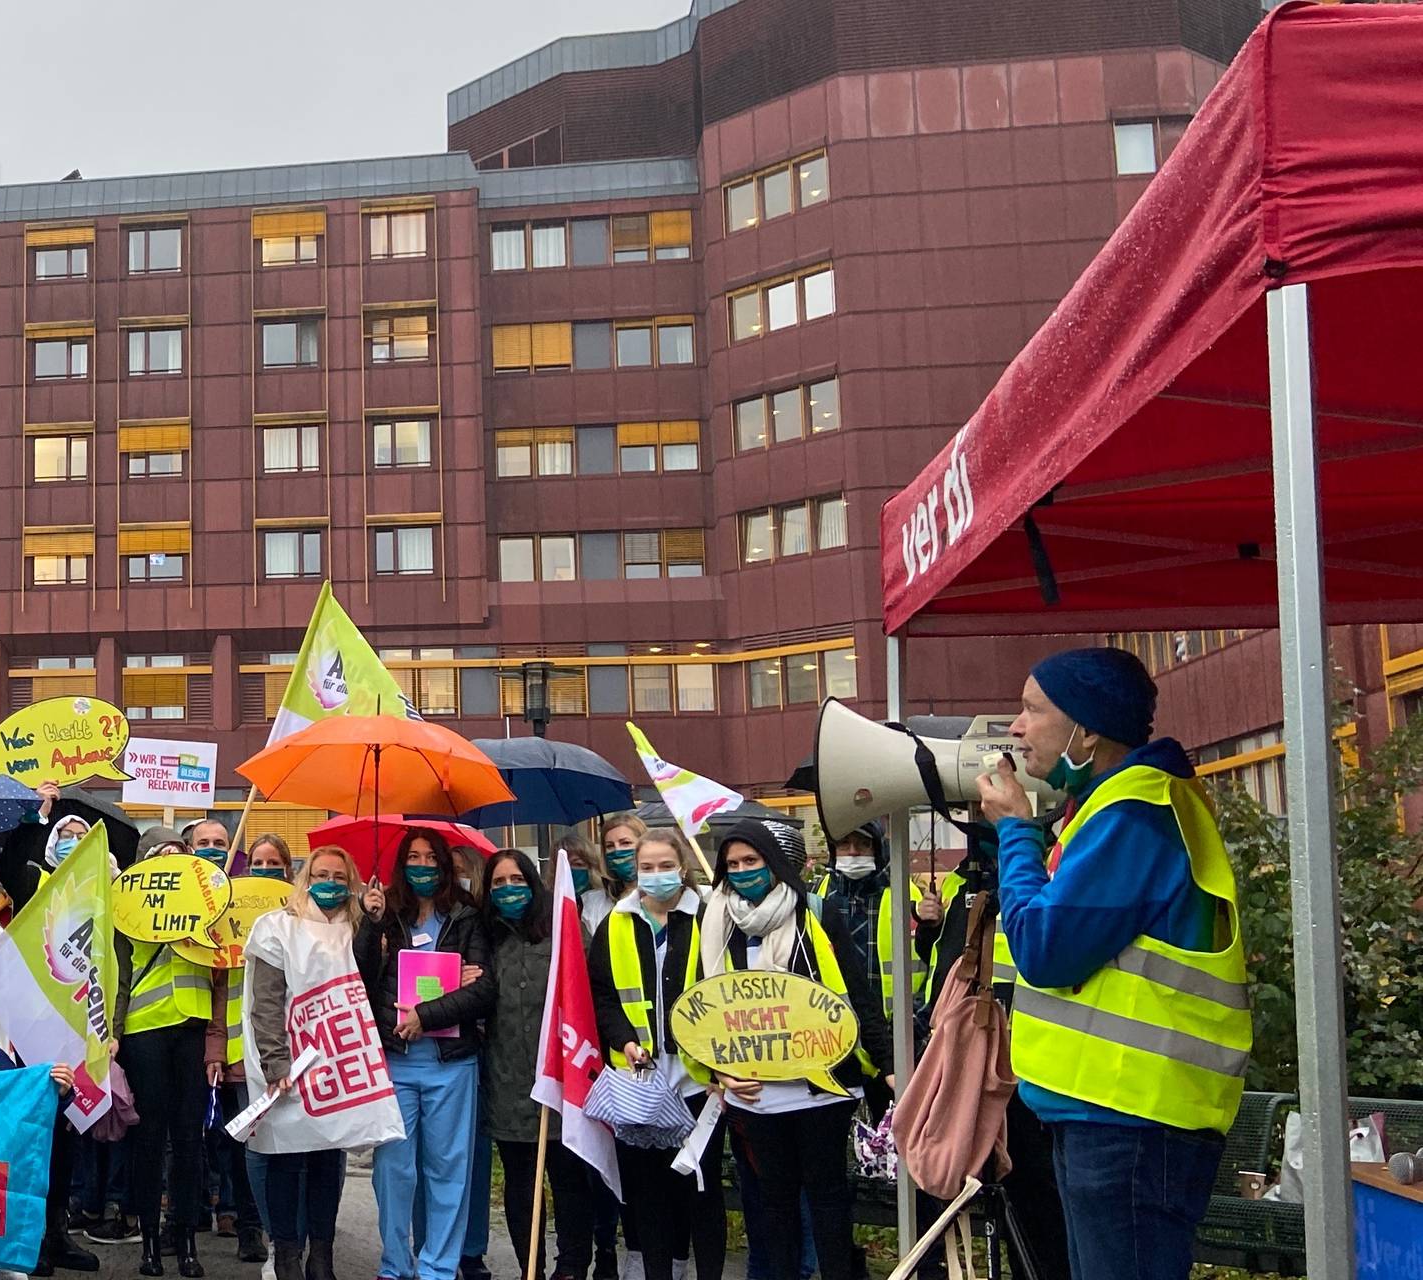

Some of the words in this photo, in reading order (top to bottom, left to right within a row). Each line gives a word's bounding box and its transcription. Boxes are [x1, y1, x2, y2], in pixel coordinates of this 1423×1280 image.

[0, 727, 35, 751] Was
[43, 719, 94, 742] bleibt
[976, 743, 1014, 752] SUPER
[6, 757, 39, 775] vom
[51, 746, 114, 776] Applaus
[139, 754, 157, 765] WIR
[135, 767, 173, 779] SYSTEM-
[148, 780, 189, 792] RELEVANT
[120, 871, 183, 892] PFLEGE
[142, 893, 165, 909] AM
[152, 912, 202, 932] LIMIT
[59, 942, 73, 959] für
[72, 957, 87, 974] die
[294, 995, 343, 1028] WEIL
[345, 984, 367, 1006] ES
[677, 990, 717, 1026] WIR
[719, 977, 787, 1004] LASSEN
[809, 988, 846, 1023] UNS
[723, 1005, 790, 1032] NICHT
